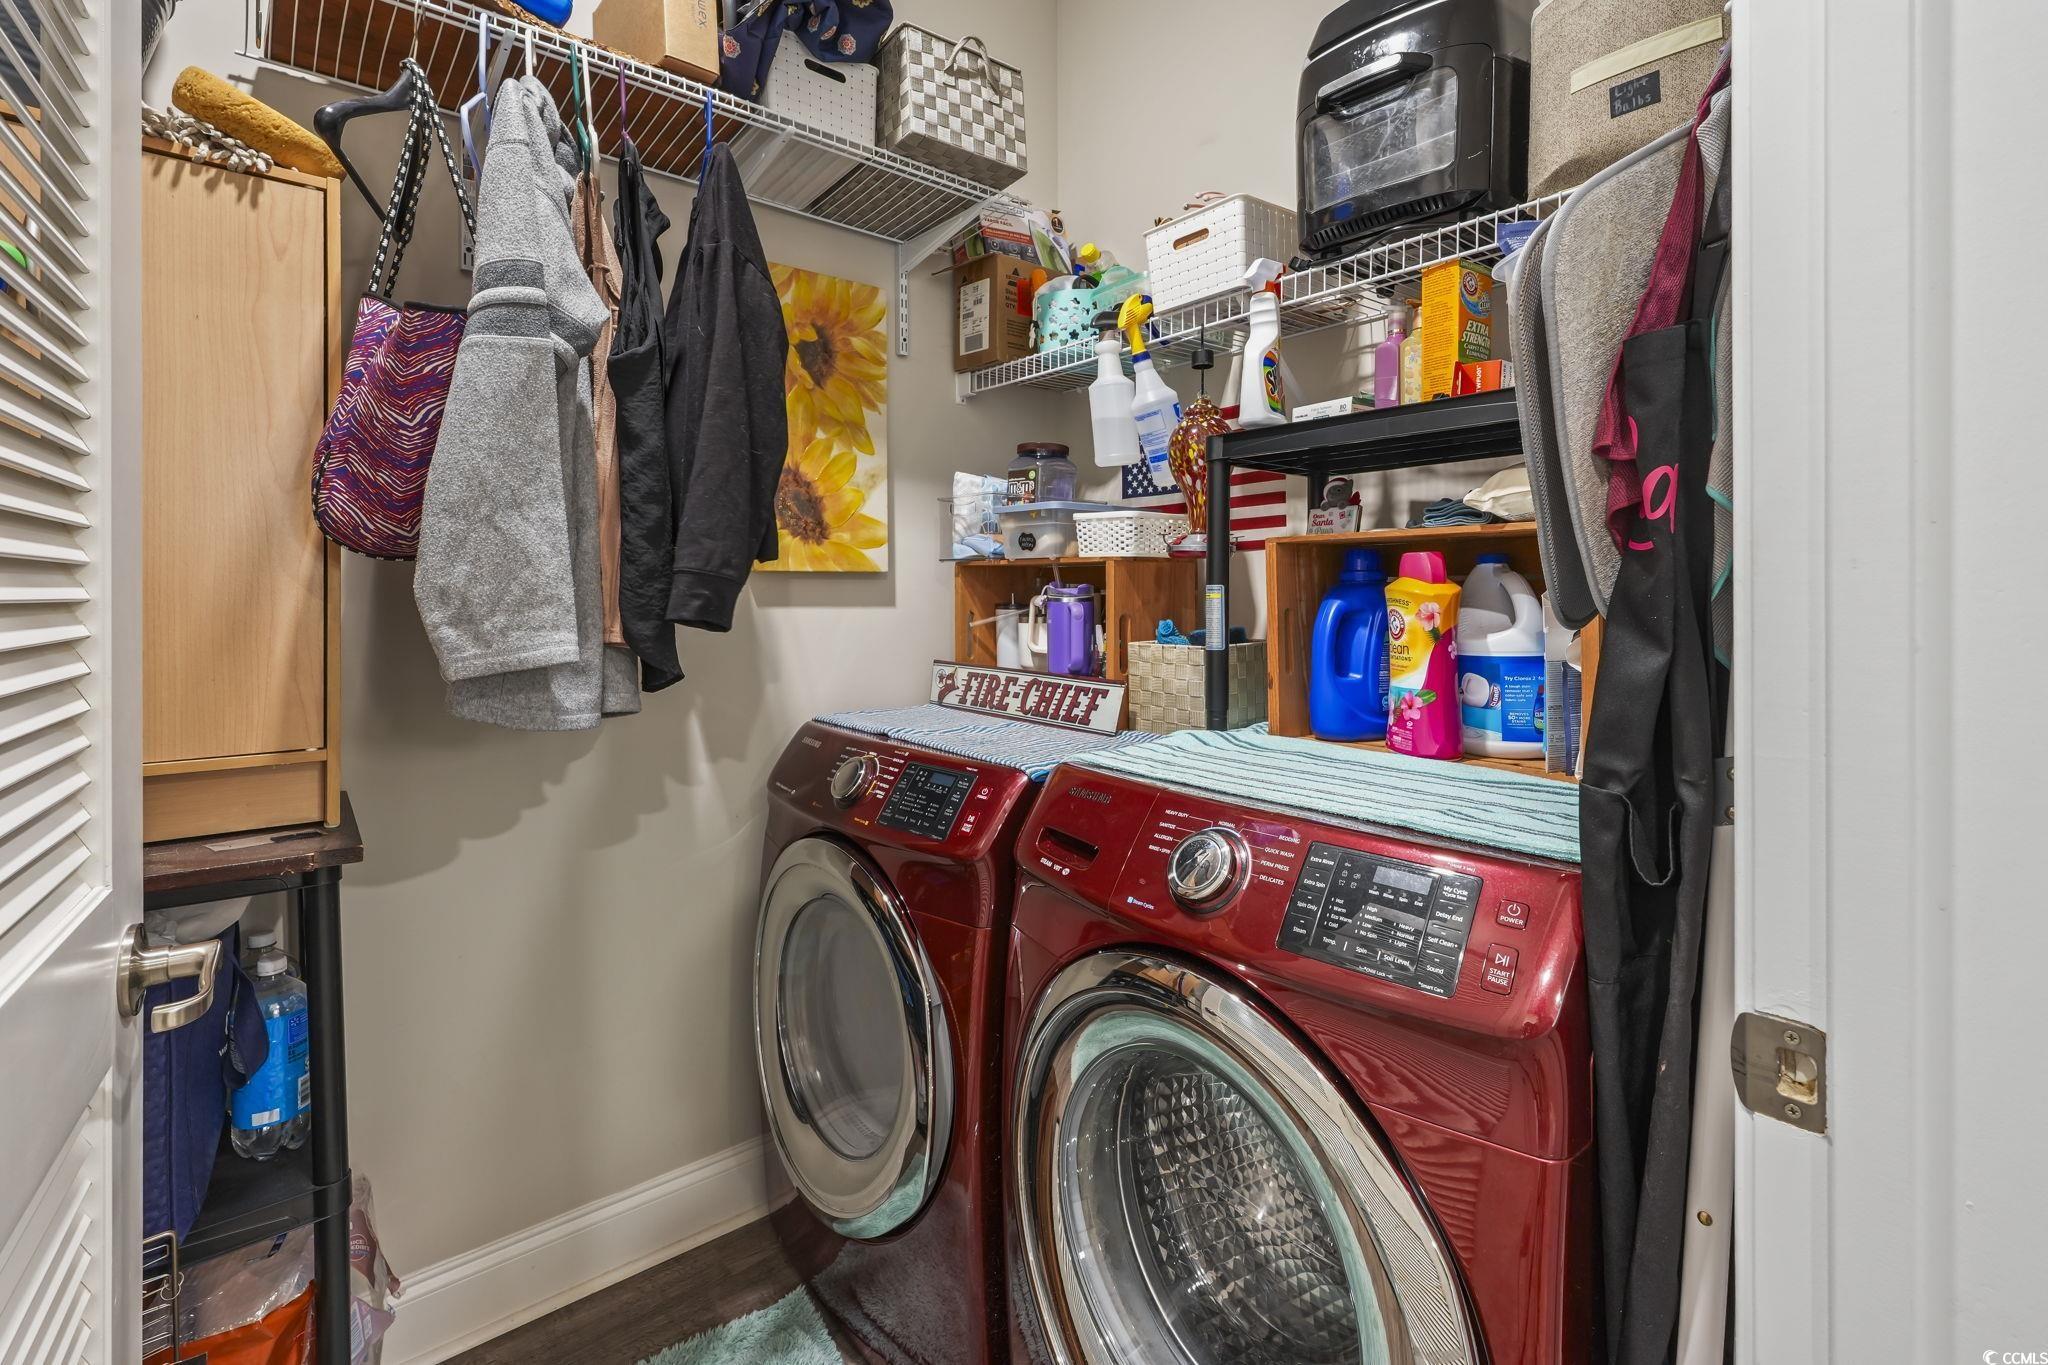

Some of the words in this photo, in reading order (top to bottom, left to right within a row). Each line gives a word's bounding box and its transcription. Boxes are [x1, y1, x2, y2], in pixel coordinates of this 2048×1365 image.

[1466, 320, 1489, 336] EXTRA
[1312, 518, 1334, 527] Santa
[1278, 835, 1300, 844] BEDDING
[1264, 846, 1280, 855] QUICK
[1280, 849, 1295, 858] WASH
[1260, 860, 1274, 869] PERM
[1274, 863, 1290, 872] PRESS
[1310, 856, 1323, 864] Extra
[1323, 858, 1335, 866] Rinse
[1259, 875, 1284, 886] DELICATES
[1303, 878, 1316, 887] Extra
[1316, 881, 1326, 889] Spin
[1297, 901, 1307, 909] Spin
[1306, 903, 1318, 912] Only
[1366, 905, 1378, 913] High
[1364, 914, 1383, 923] Medium
[1435, 911, 1451, 920] Delay
[1452, 914, 1463, 922] End
[1500, 915, 1524, 925] POWER
[1398, 923, 1415, 932] Heavy
[1367, 931, 1378, 939] Spin
[1396, 931, 1415, 940] Normal
[1427, 935, 1439, 944] Self
[1394, 940, 1408, 948] Light
[1355, 946, 1368, 954] Spin
[1383, 954, 1394, 962] Soil
[1394, 957, 1411, 966] Level
[1426, 964, 1444, 974] Sound
[1489, 967, 1511, 978] START
[1487, 976, 1509, 986] PAUSE
[1433, 985, 1444, 993] Care
